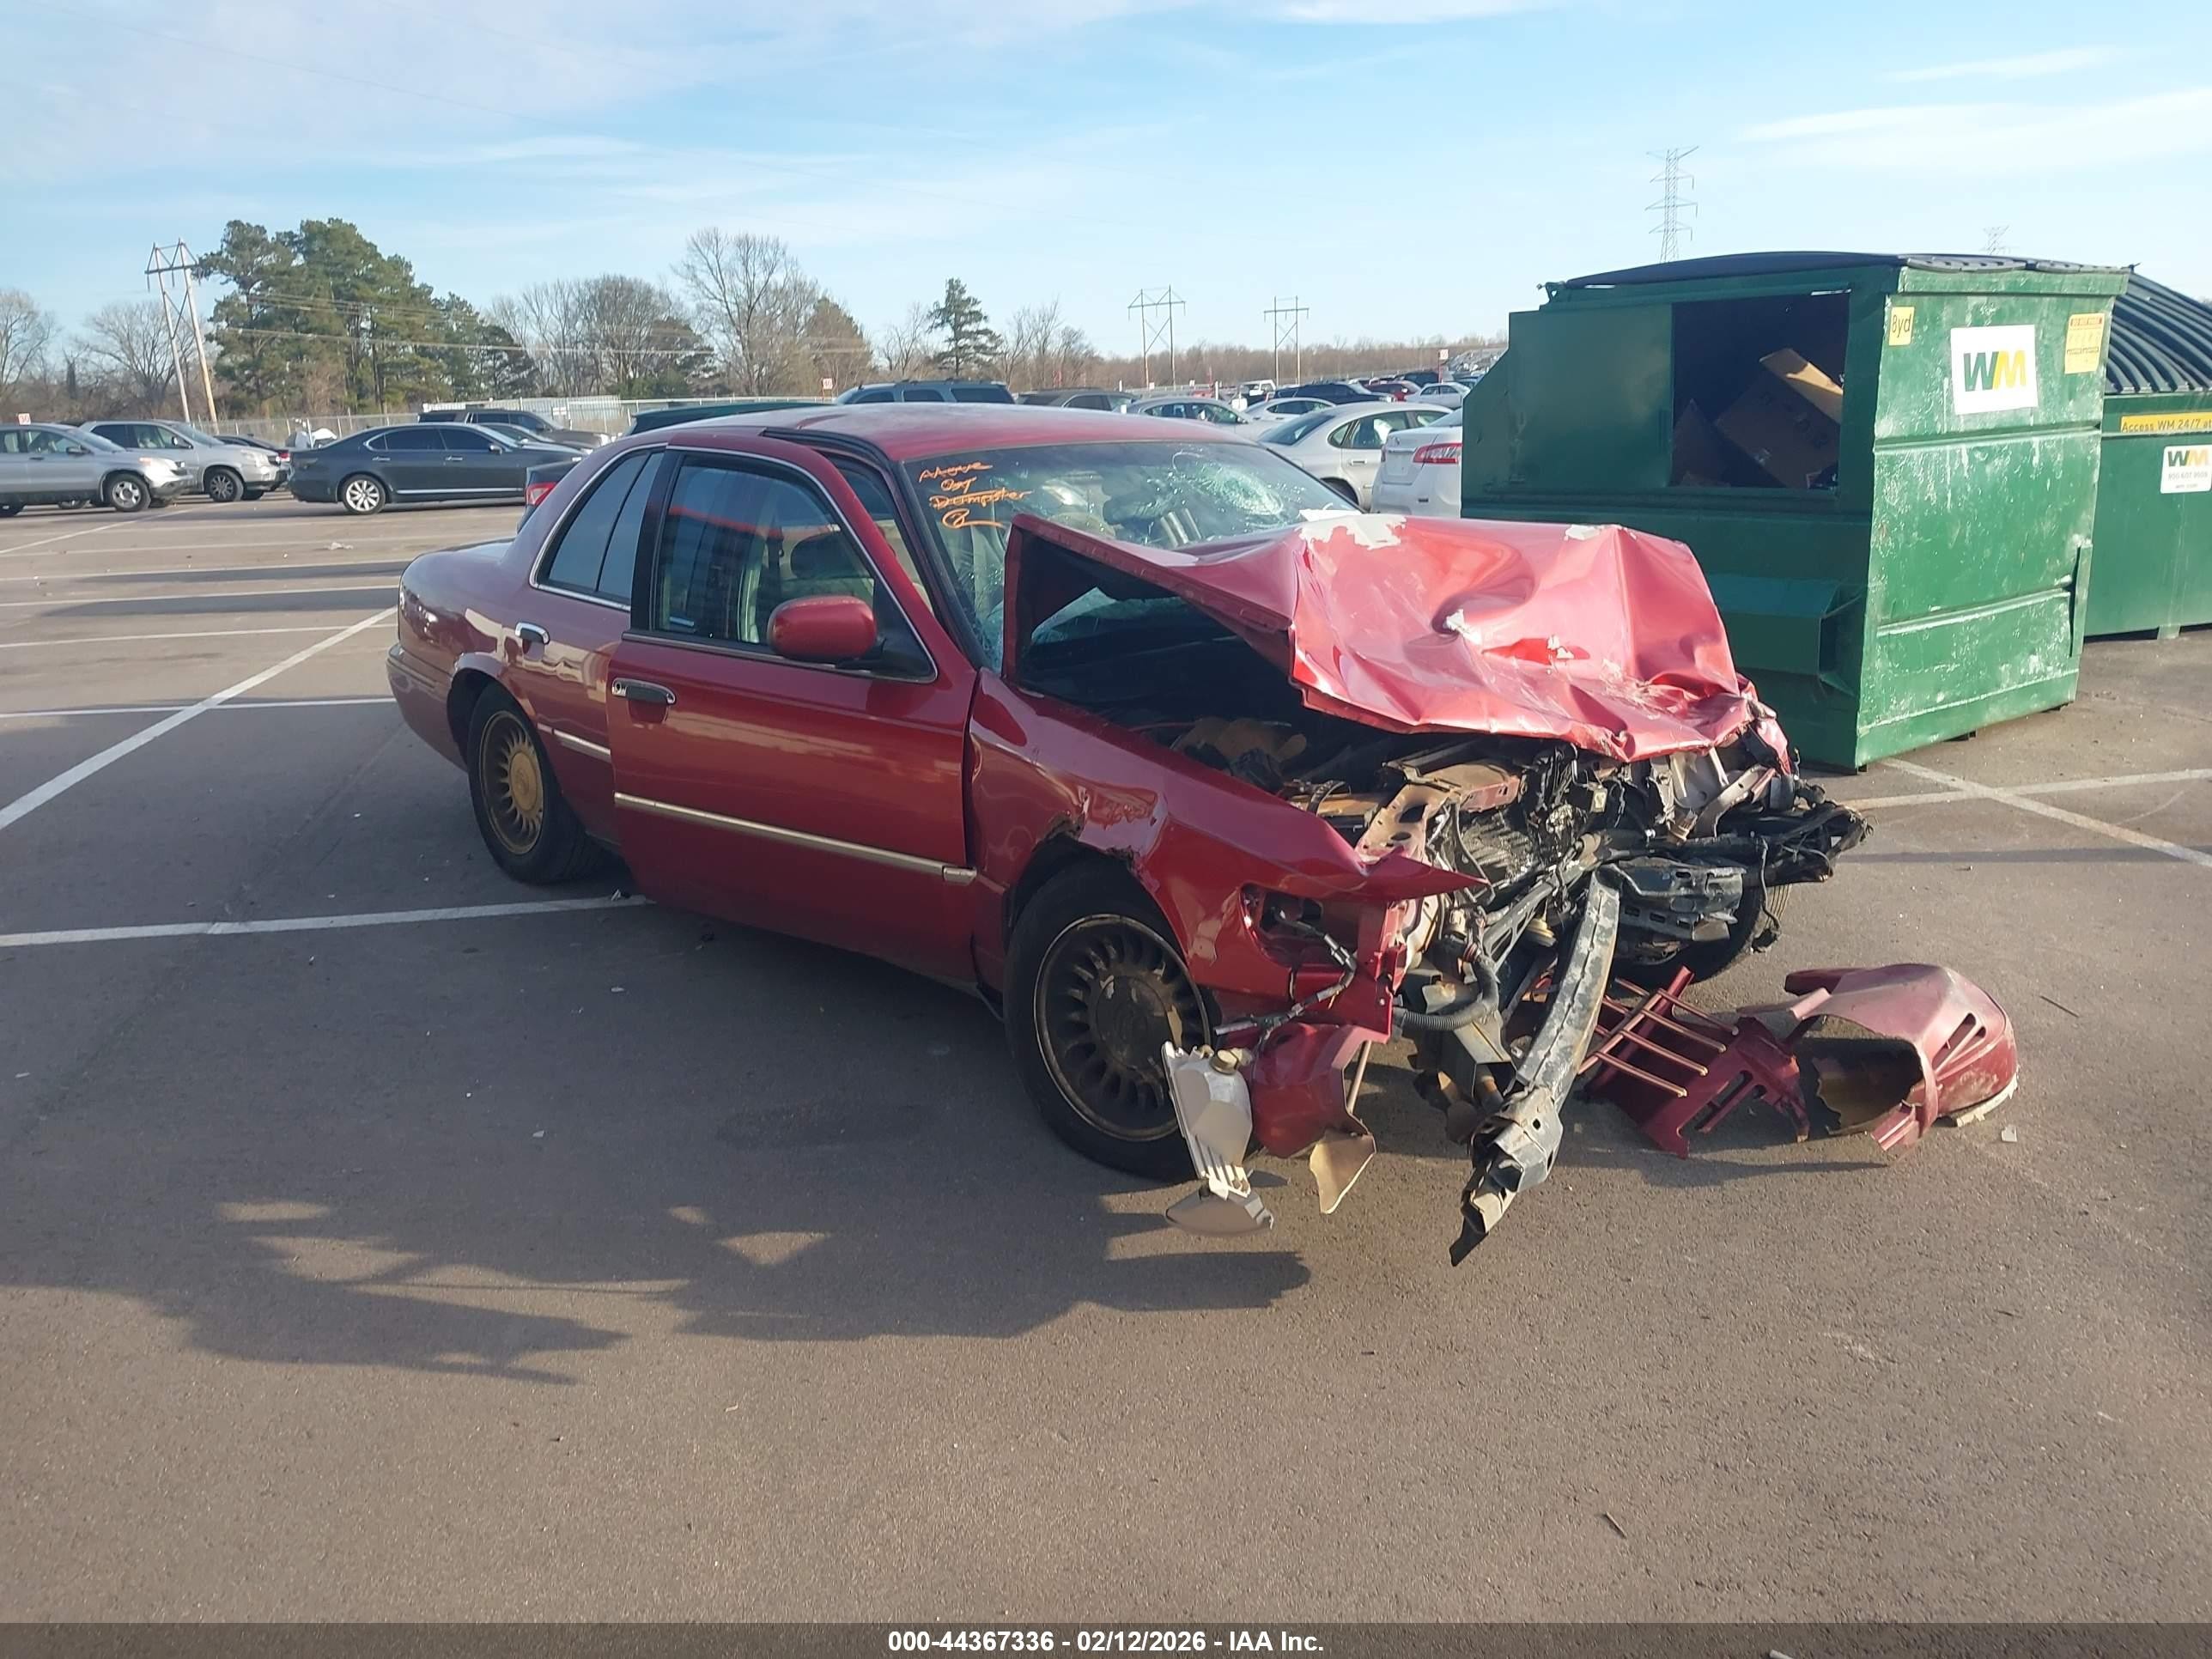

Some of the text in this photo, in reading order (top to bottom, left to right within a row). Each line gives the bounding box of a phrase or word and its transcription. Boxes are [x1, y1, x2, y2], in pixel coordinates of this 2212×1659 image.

[1892, 312, 1912, 338] 8yd
[1963, 350, 2027, 392] WM
[2122, 422, 2154, 433] Access
[2157, 419, 2176, 431] WM
[2167, 449, 2209, 467] WM
